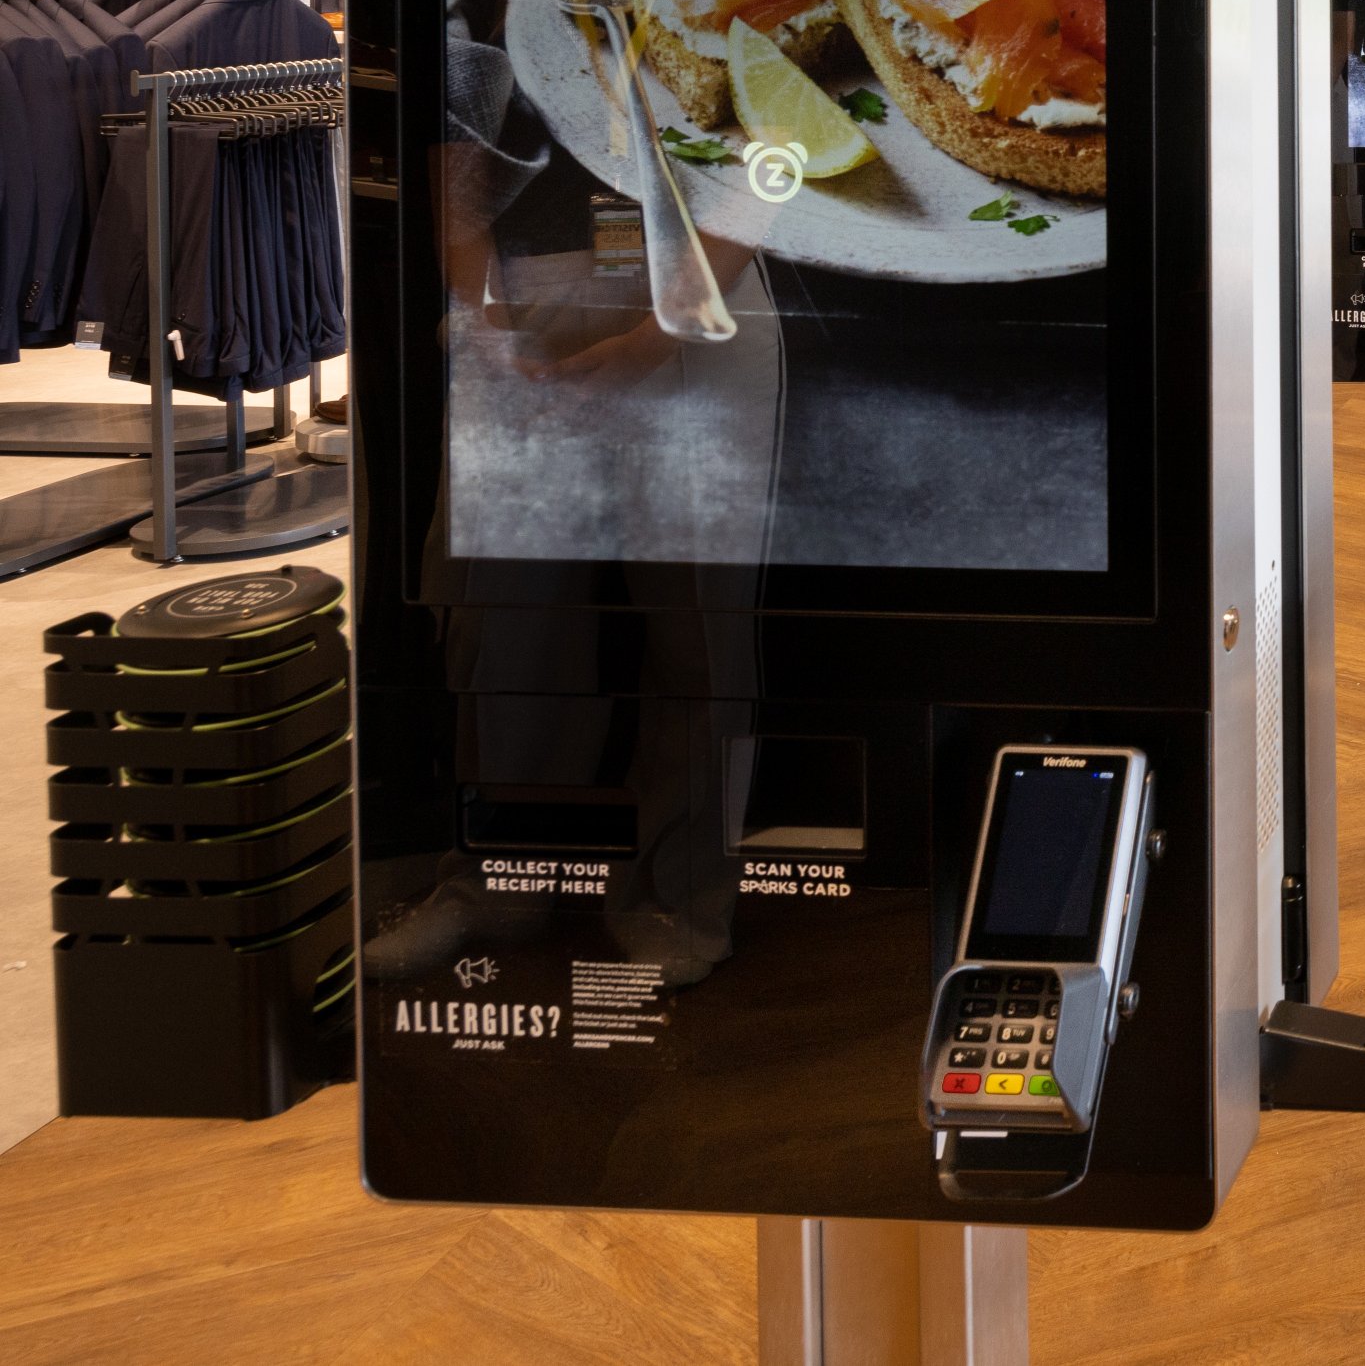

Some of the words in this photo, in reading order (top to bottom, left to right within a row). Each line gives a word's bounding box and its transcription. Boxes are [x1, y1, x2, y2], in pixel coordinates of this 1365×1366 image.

[1043, 756, 1087, 768] Verifone
[481, 859, 559, 876] COLLECT
[563, 861, 611, 878] YOUR
[744, 862, 793, 877] SCAN
[797, 864, 846, 879] YOUR
[486, 877, 557, 894] RECEIPT
[560, 879, 607, 895] HERE
[802, 882, 851, 898] CARD
[395, 1000, 561, 1038] ALLERGIES?
[959, 1026, 968, 1039] 7
[1001, 1027, 1011, 1040] 8
[1045, 1028, 1055, 1040] 9
[452, 1039, 480, 1049] JUST
[482, 1039, 506, 1050] ASK
[997, 1052, 1007, 1065] 0
